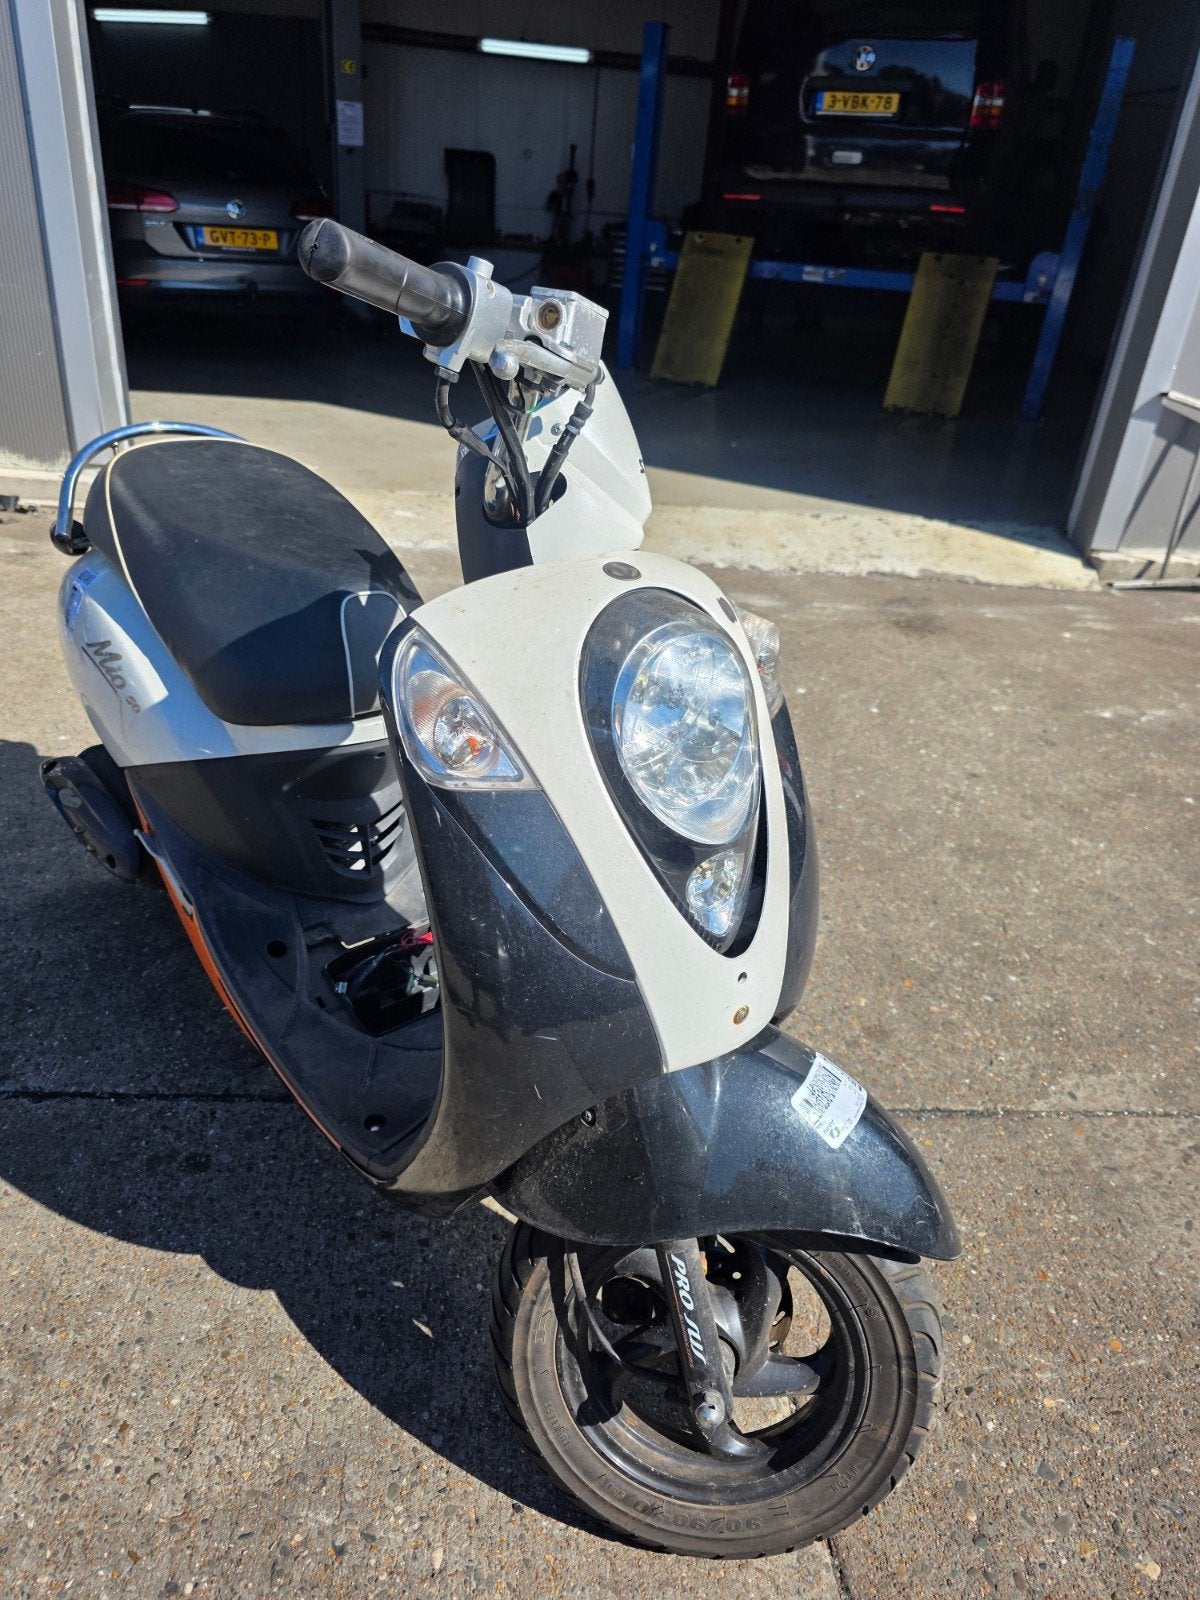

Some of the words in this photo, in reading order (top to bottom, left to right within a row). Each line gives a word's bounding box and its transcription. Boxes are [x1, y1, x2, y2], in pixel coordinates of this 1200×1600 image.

[209, 229, 271, 246] GVT-73-P
[86, 640, 128, 690] Mio
[671, 1254, 695, 1311] PRO
[545, 1402, 571, 1448] TUBELESS
